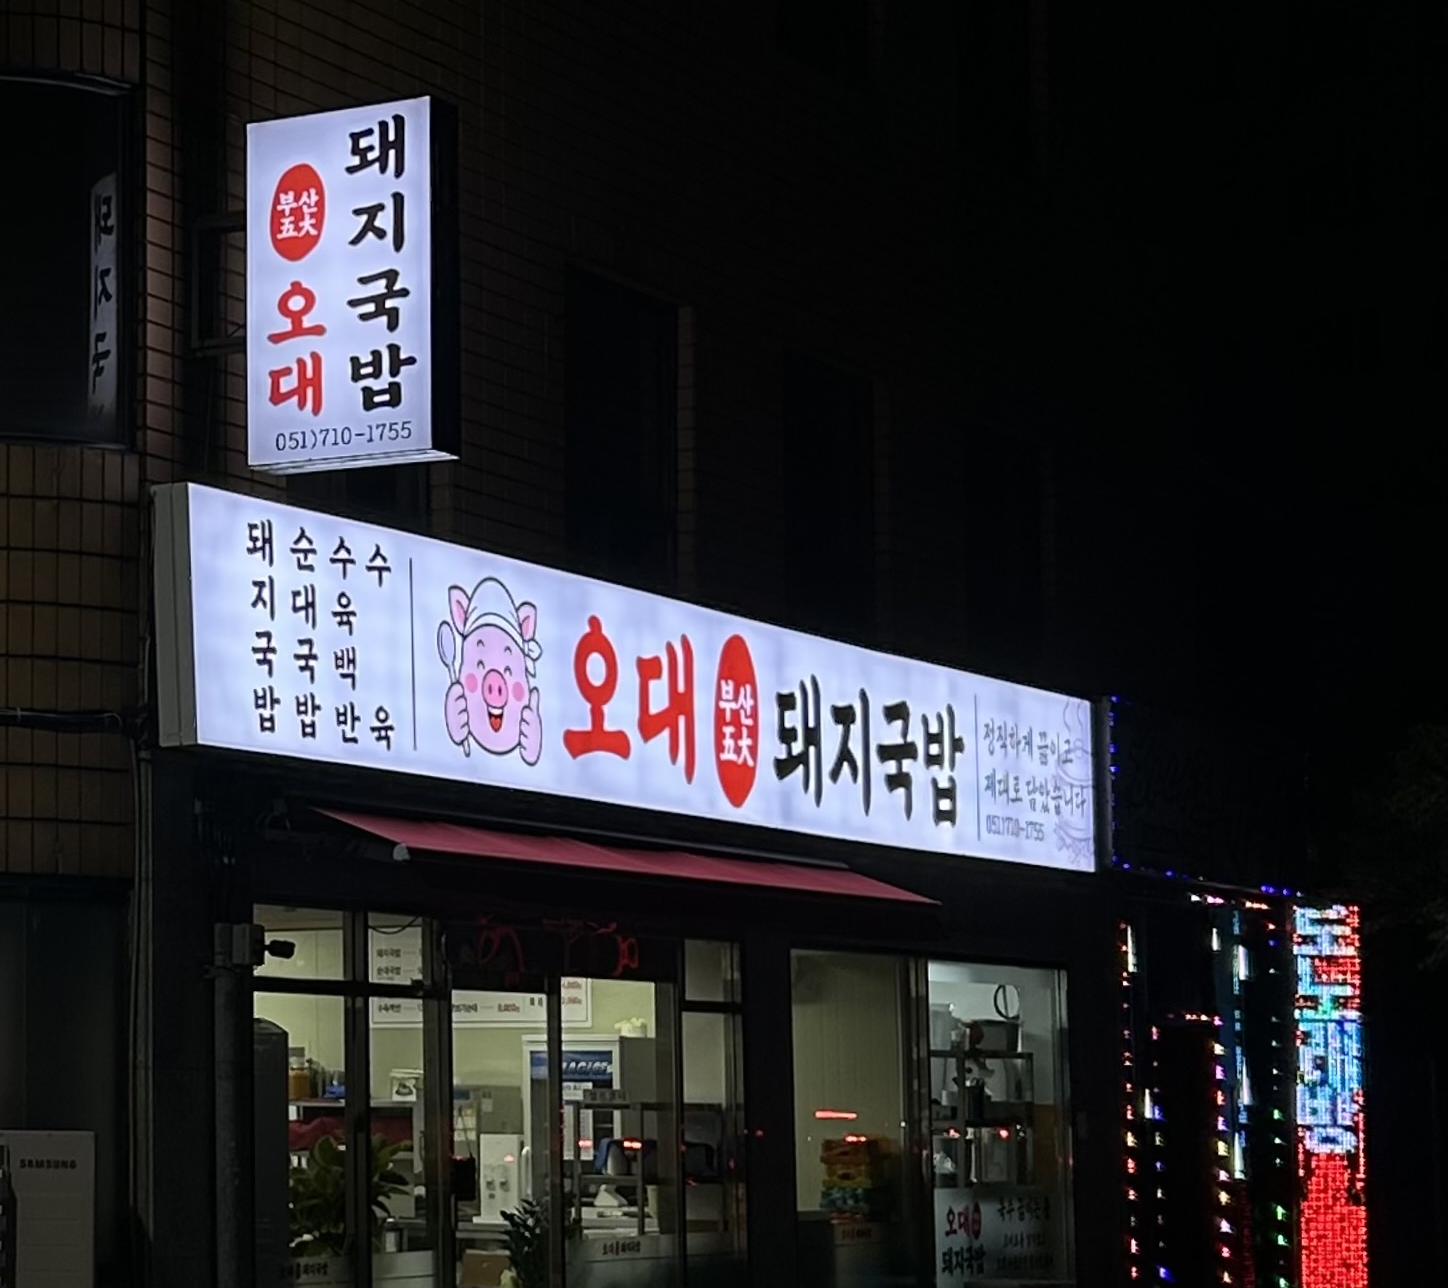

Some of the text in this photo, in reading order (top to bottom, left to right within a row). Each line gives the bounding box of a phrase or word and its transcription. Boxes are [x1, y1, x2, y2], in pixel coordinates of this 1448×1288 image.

[276, 188, 319, 217] 부산
[276, 216, 318, 240] 五大
[345, 114, 417, 412] 돼지국밥
[267, 280, 326, 416] 오대
[276, 421, 412, 451] 051)710-1755
[246, 519, 281, 733] 돼지국밥
[289, 527, 321, 739] 순대국밥
[329, 536, 361, 745] 수육백반
[365, 544, 395, 751] 수육
[562, 614, 696, 785] 오대
[718, 679, 755, 725] 부산
[719, 724, 754, 766] 五大
[983, 717, 1073, 766] 정직하게 끓이고
[773, 674, 964, 828] 돼지국밥
[984, 768, 1087, 818] 제대로 담았습니다
[19, 1158, 78, 1170] SAMSUNG
